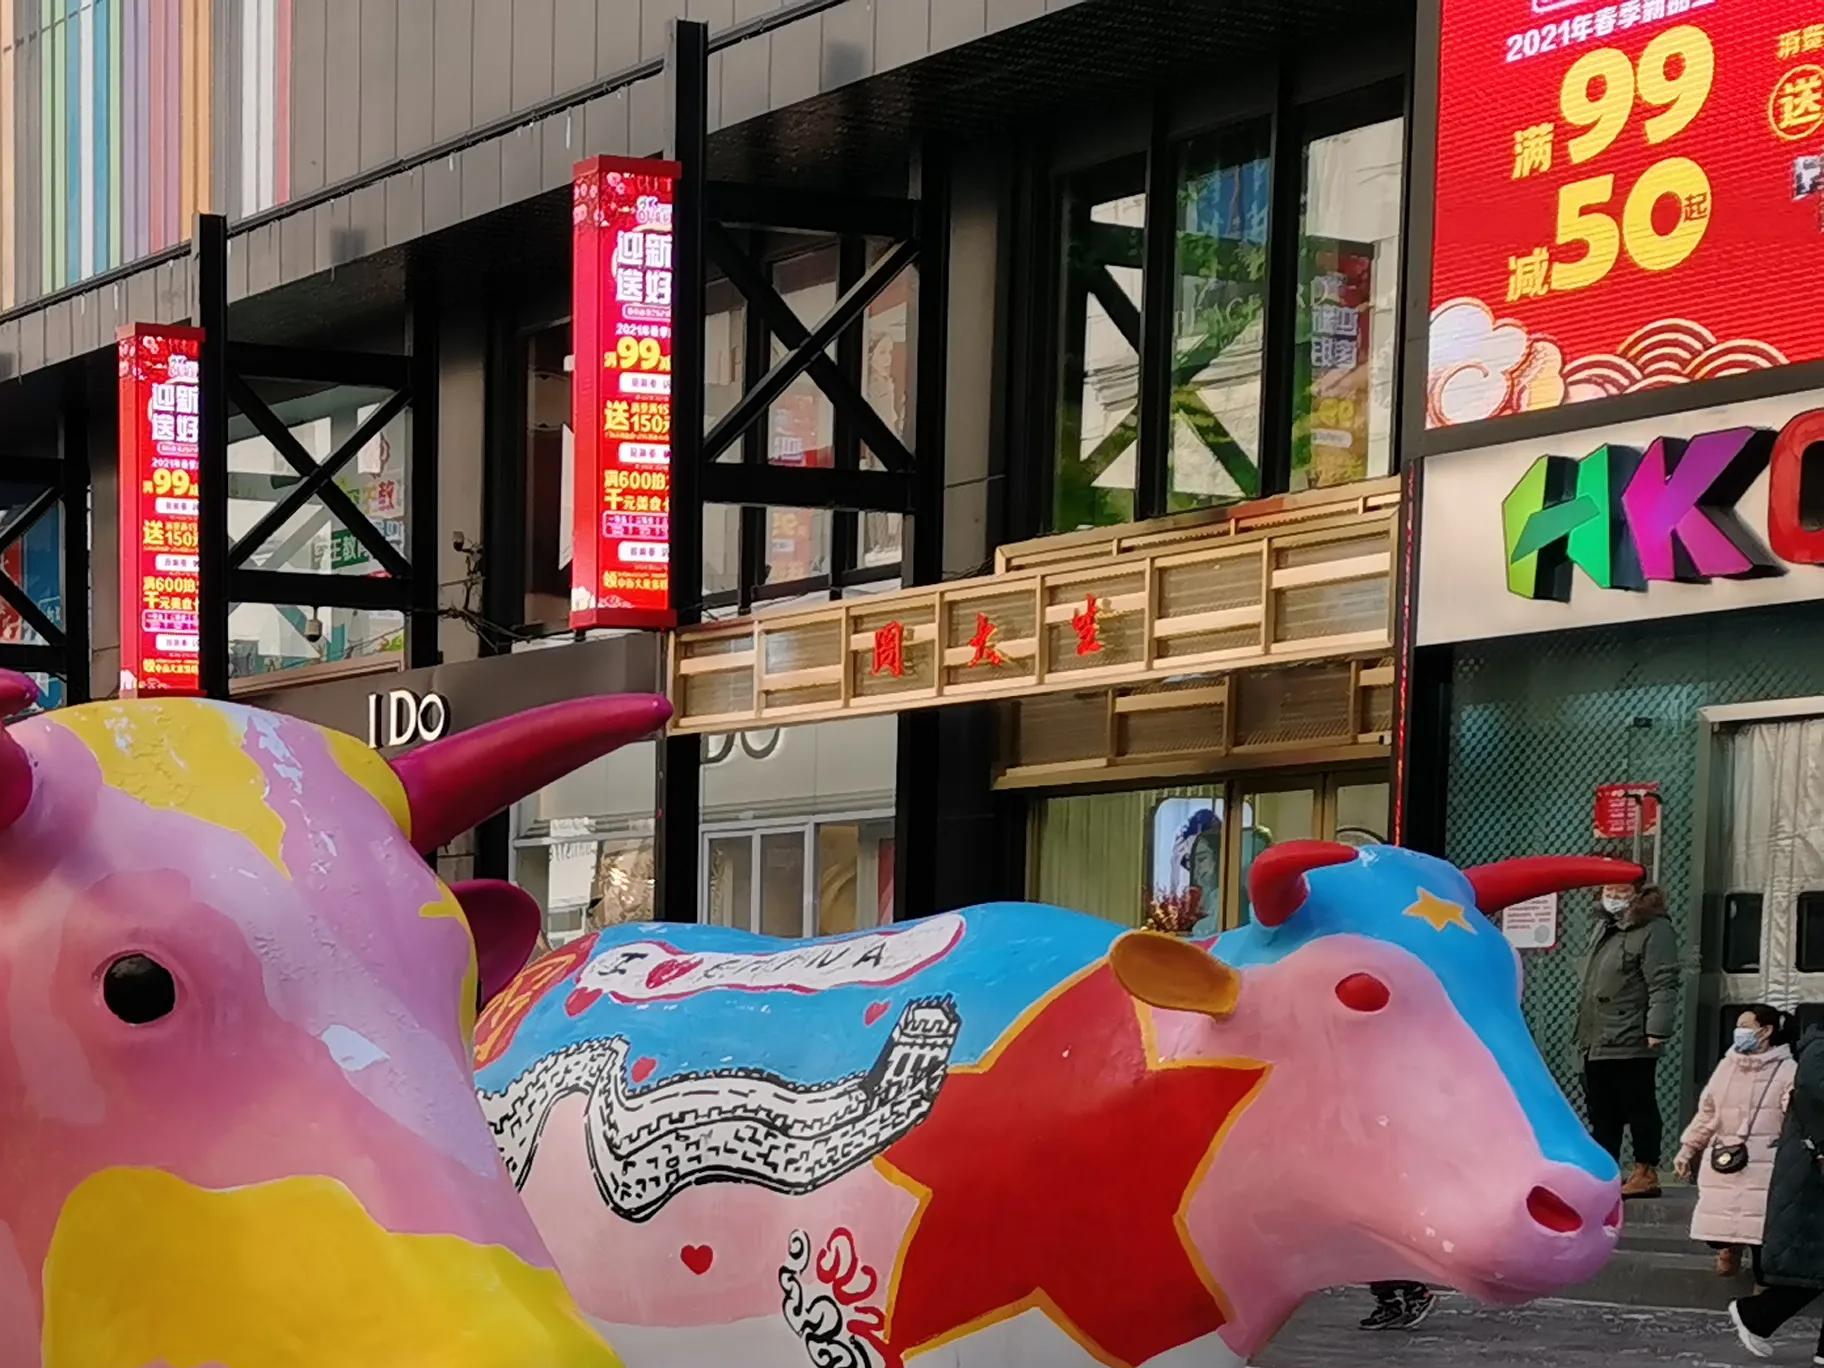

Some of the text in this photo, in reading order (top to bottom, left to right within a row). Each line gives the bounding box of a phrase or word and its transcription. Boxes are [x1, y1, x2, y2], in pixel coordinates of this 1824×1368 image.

[616, 323, 672, 338] 2021年春季
[389, 690, 445, 746] DO
